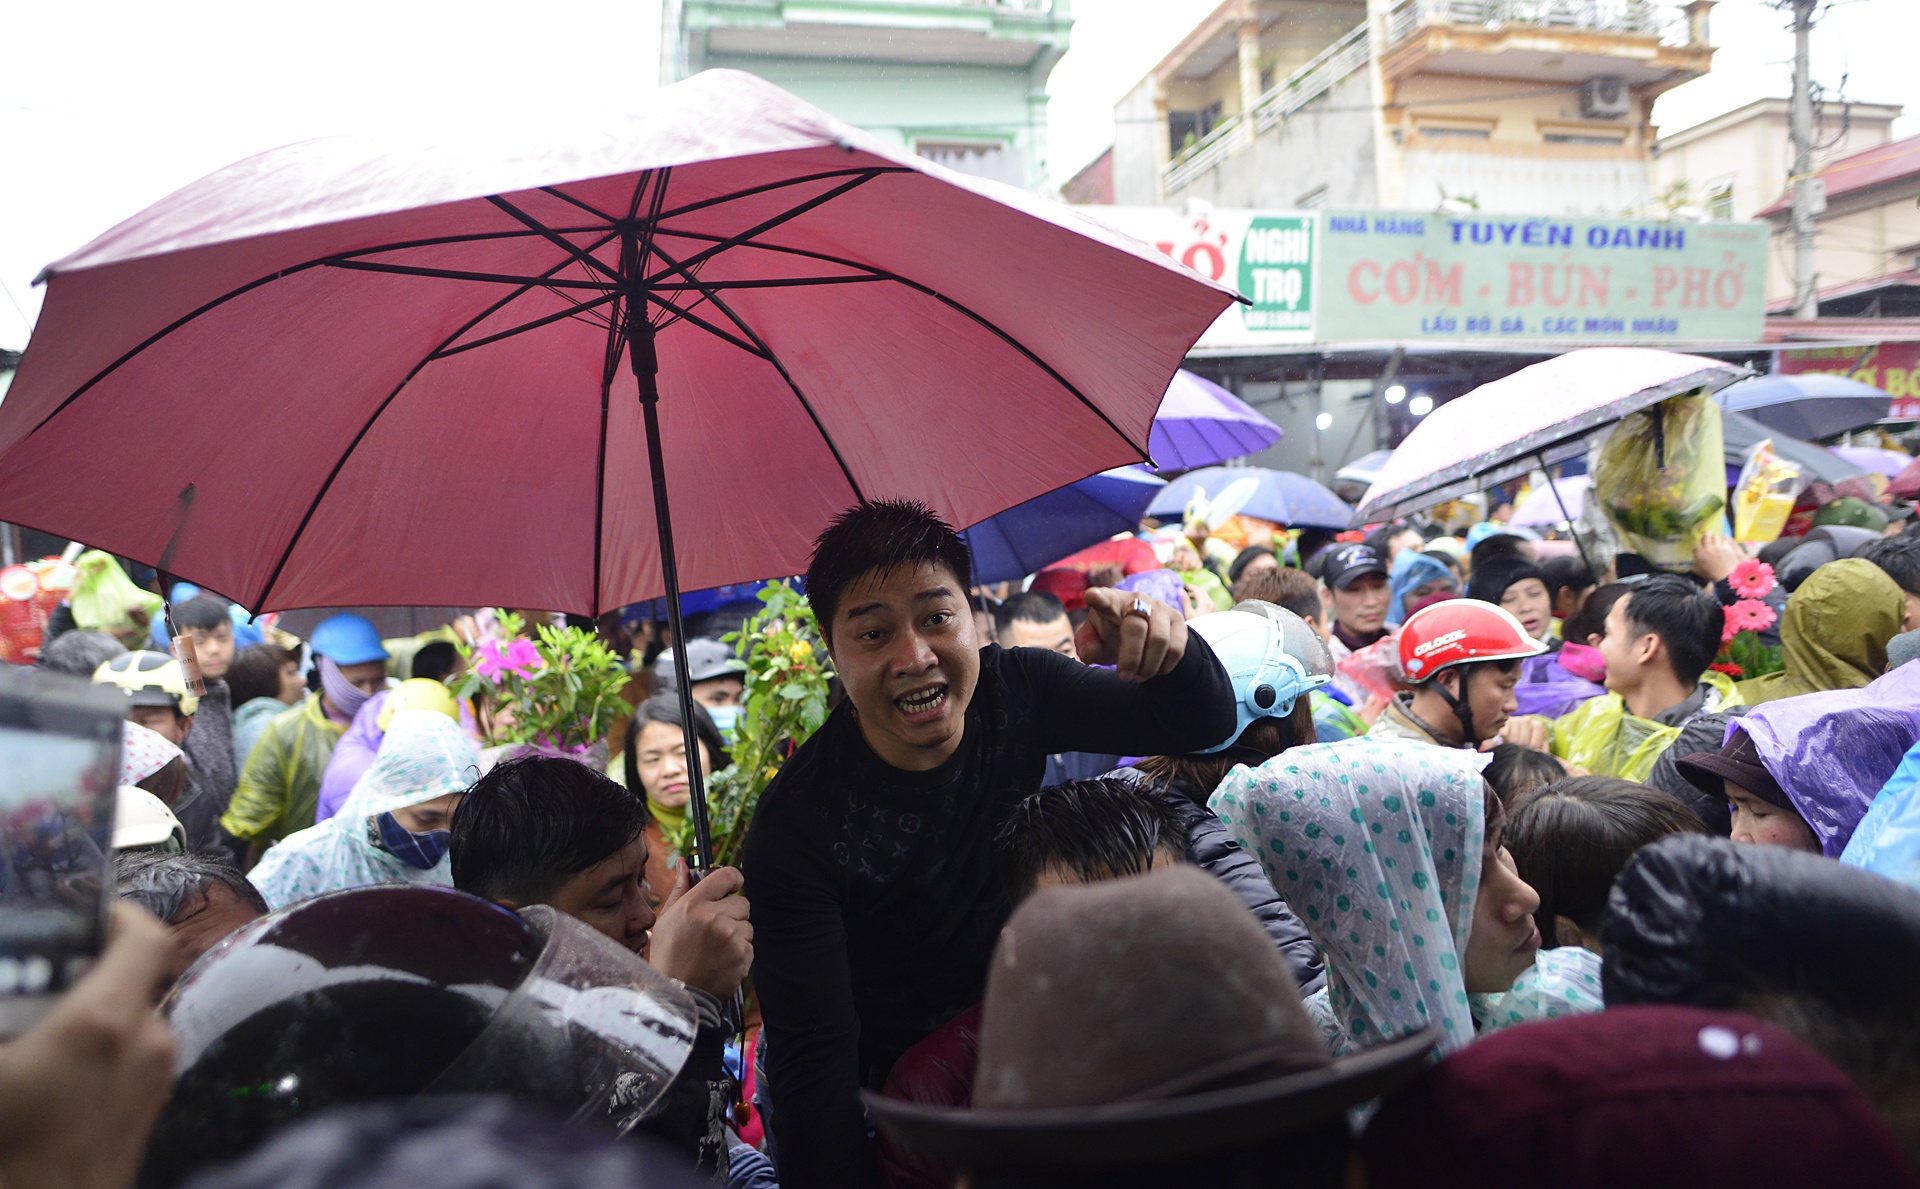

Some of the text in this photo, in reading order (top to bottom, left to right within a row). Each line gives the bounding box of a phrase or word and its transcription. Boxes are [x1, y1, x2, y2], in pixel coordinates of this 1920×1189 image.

[1586, 224, 1686, 251] OANH
[1250, 267, 1303, 310] TRỌ
[1348, 252, 1464, 305] CƠM
[1507, 254, 1612, 307] BÚN
[1653, 250, 1746, 309] PHỞ
